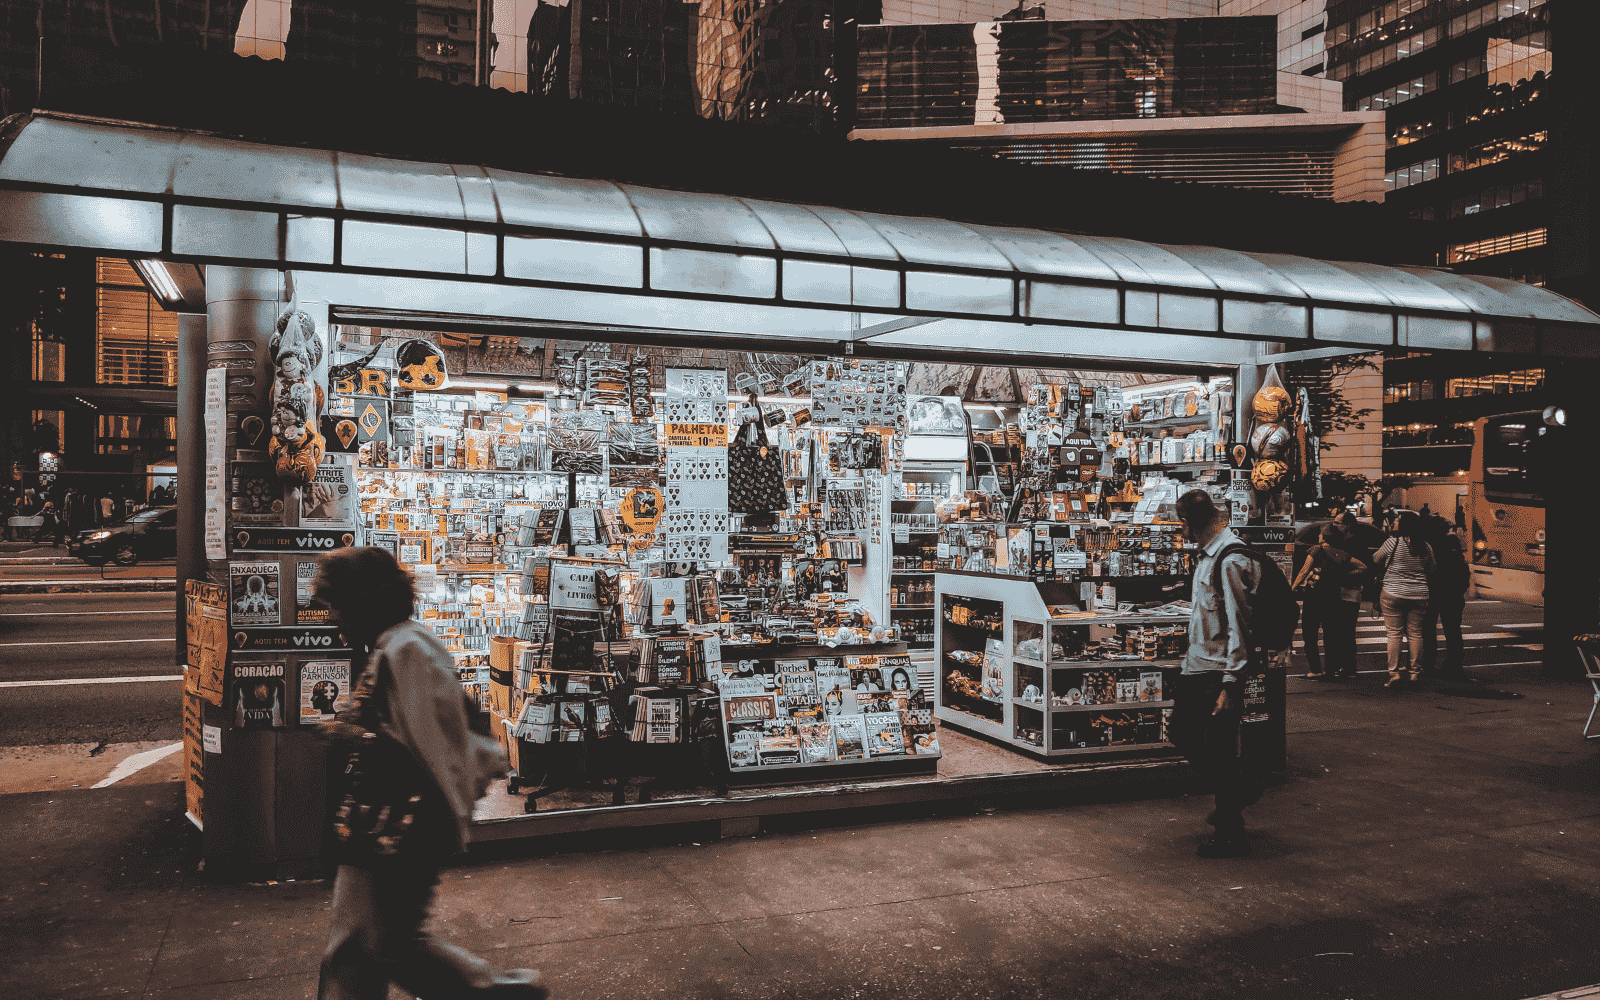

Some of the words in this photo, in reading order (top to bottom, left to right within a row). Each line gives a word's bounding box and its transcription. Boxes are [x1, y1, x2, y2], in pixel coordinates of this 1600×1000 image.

[671, 424, 725, 434] PALHETAS
[1263, 529, 1285, 540] vivo
[295, 533, 335, 548] vivo
[231, 566, 279, 574] ENXAQUECA
[569, 574, 596, 583] CAPA
[567, 591, 597, 600] LIVROS
[273, 637, 287, 645] TEM
[293, 632, 332, 646] vivo
[234, 664, 284, 678] CORAÇÃO
[302, 665, 347, 674] ALZHEIMER
[777, 663, 808, 673] Forbes
[301, 672, 346, 680] PARKINSON
[784, 675, 814, 684] Forbes
[729, 700, 771, 718] CLASSIC
[247, 711, 271, 720] VIDA
